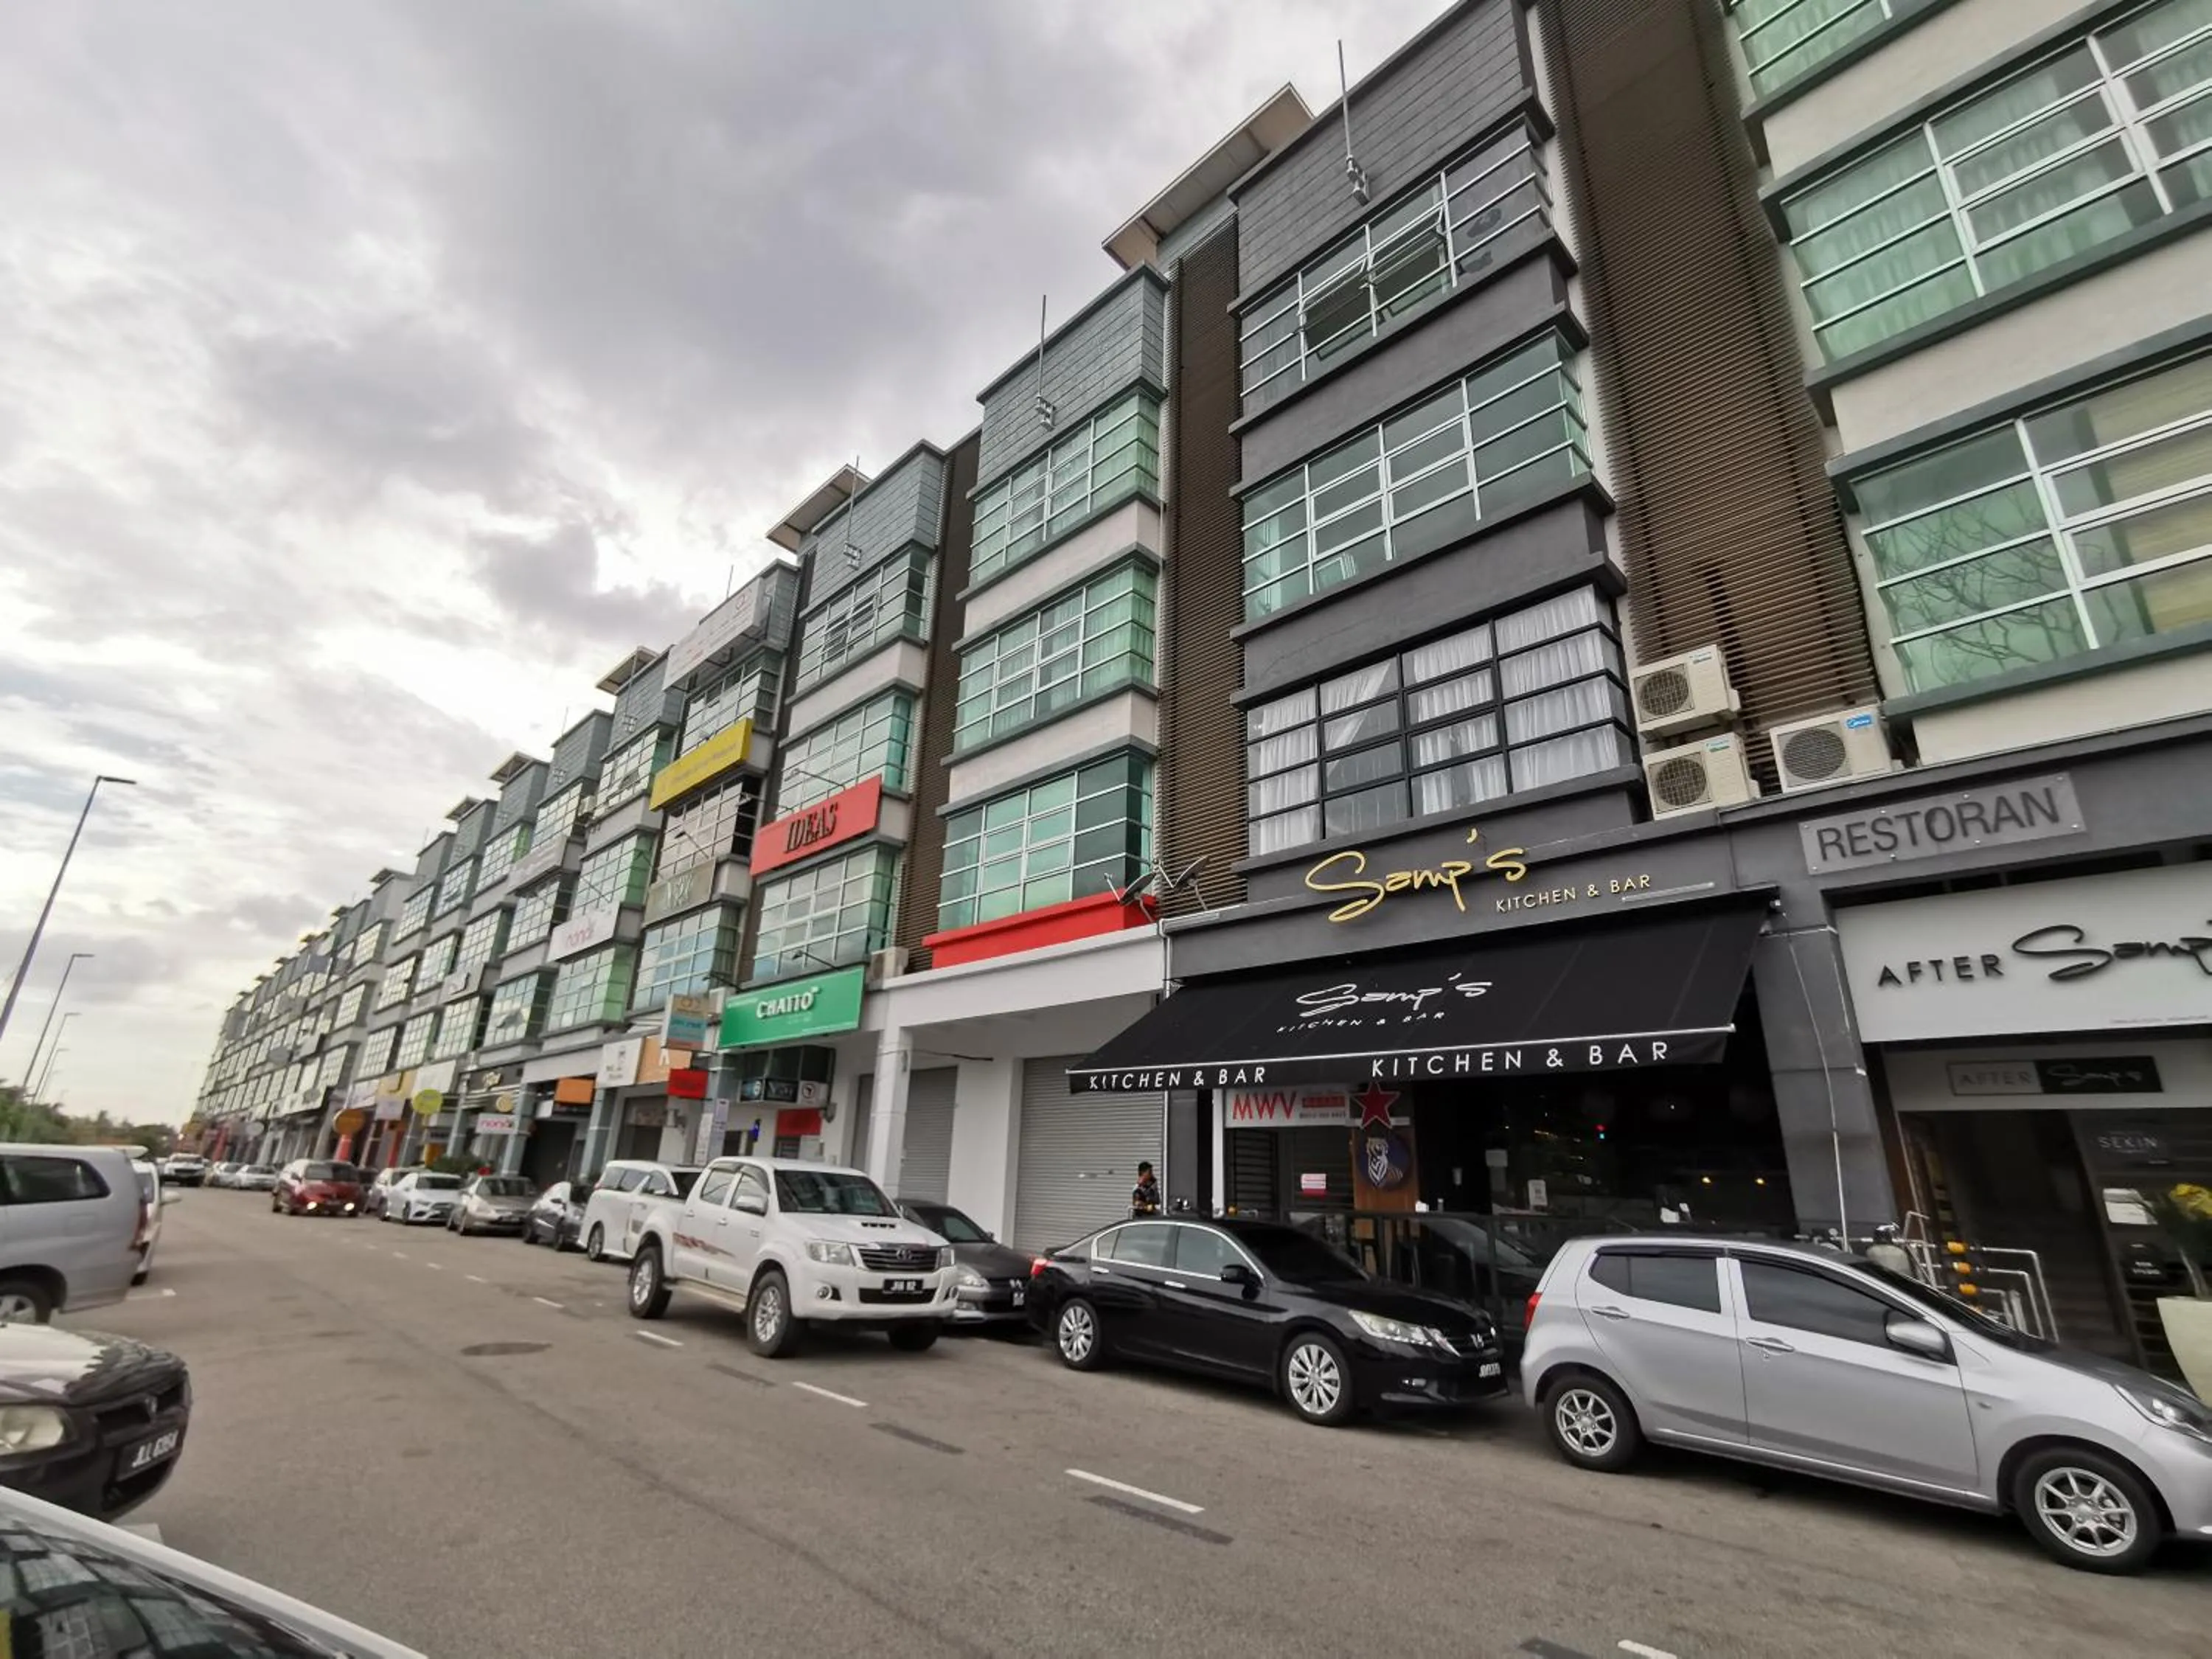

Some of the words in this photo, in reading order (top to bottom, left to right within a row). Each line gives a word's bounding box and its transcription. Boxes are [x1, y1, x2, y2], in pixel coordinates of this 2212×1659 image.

[785, 801, 838, 854] IDEAS
[1816, 786, 2061, 862] RESTORAN
[1304, 827, 1527, 923] Samp's
[1495, 886, 1576, 913] KITCHEN
[1587, 883, 1599, 897] &
[1610, 874, 1652, 893] BAR
[1877, 953, 2004, 988] AFTER
[1295, 973, 1493, 1018] Samp's
[1276, 1019, 1363, 1033] KITCHEN
[1371, 1049, 1522, 1078] KITCHEN
[1546, 1047, 1564, 1068] &
[1588, 1040, 1668, 1066] BAR
[1089, 1071, 1181, 1090] KITCHEN
[1193, 1070, 1205, 1086] &
[1218, 1067, 1265, 1085] BAR
[1958, 1071, 2033, 1088] AFTER
[1233, 1091, 1296, 1120] MWV
